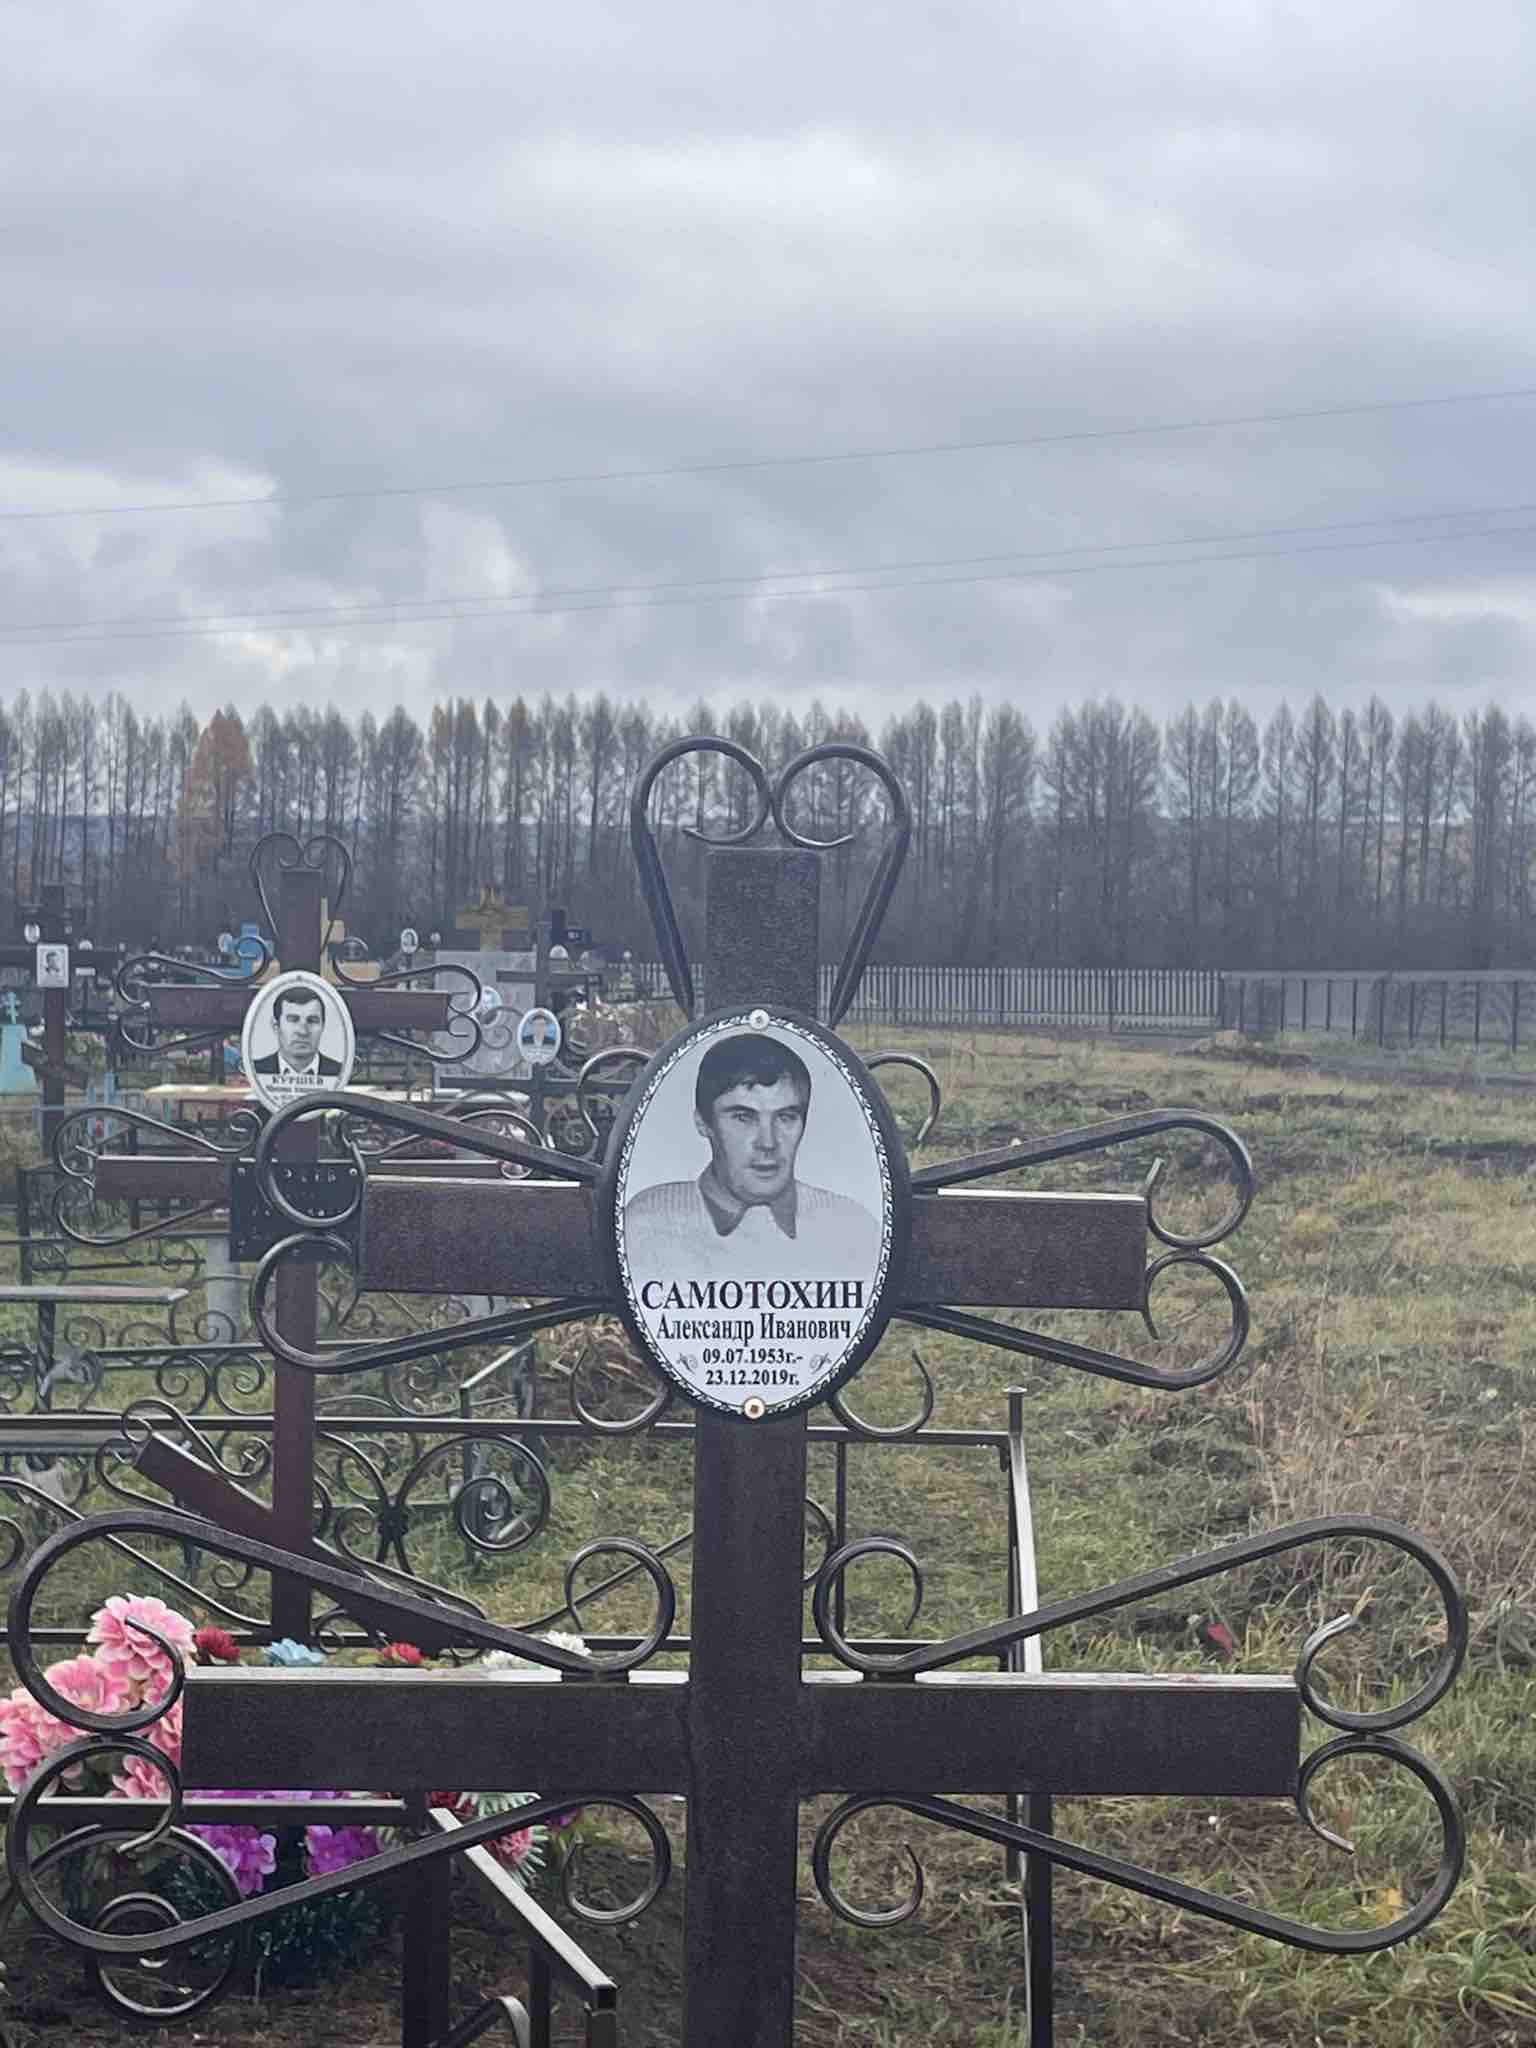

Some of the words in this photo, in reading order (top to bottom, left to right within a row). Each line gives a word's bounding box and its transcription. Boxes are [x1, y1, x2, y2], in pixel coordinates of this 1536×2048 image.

[641, 1280, 864, 1310] САМОТОХИН
[656, 1314, 754, 1347] Александр
[760, 1312, 851, 1339] Иванович
[705, 1369, 800, 1385] 23.12.2019г.
